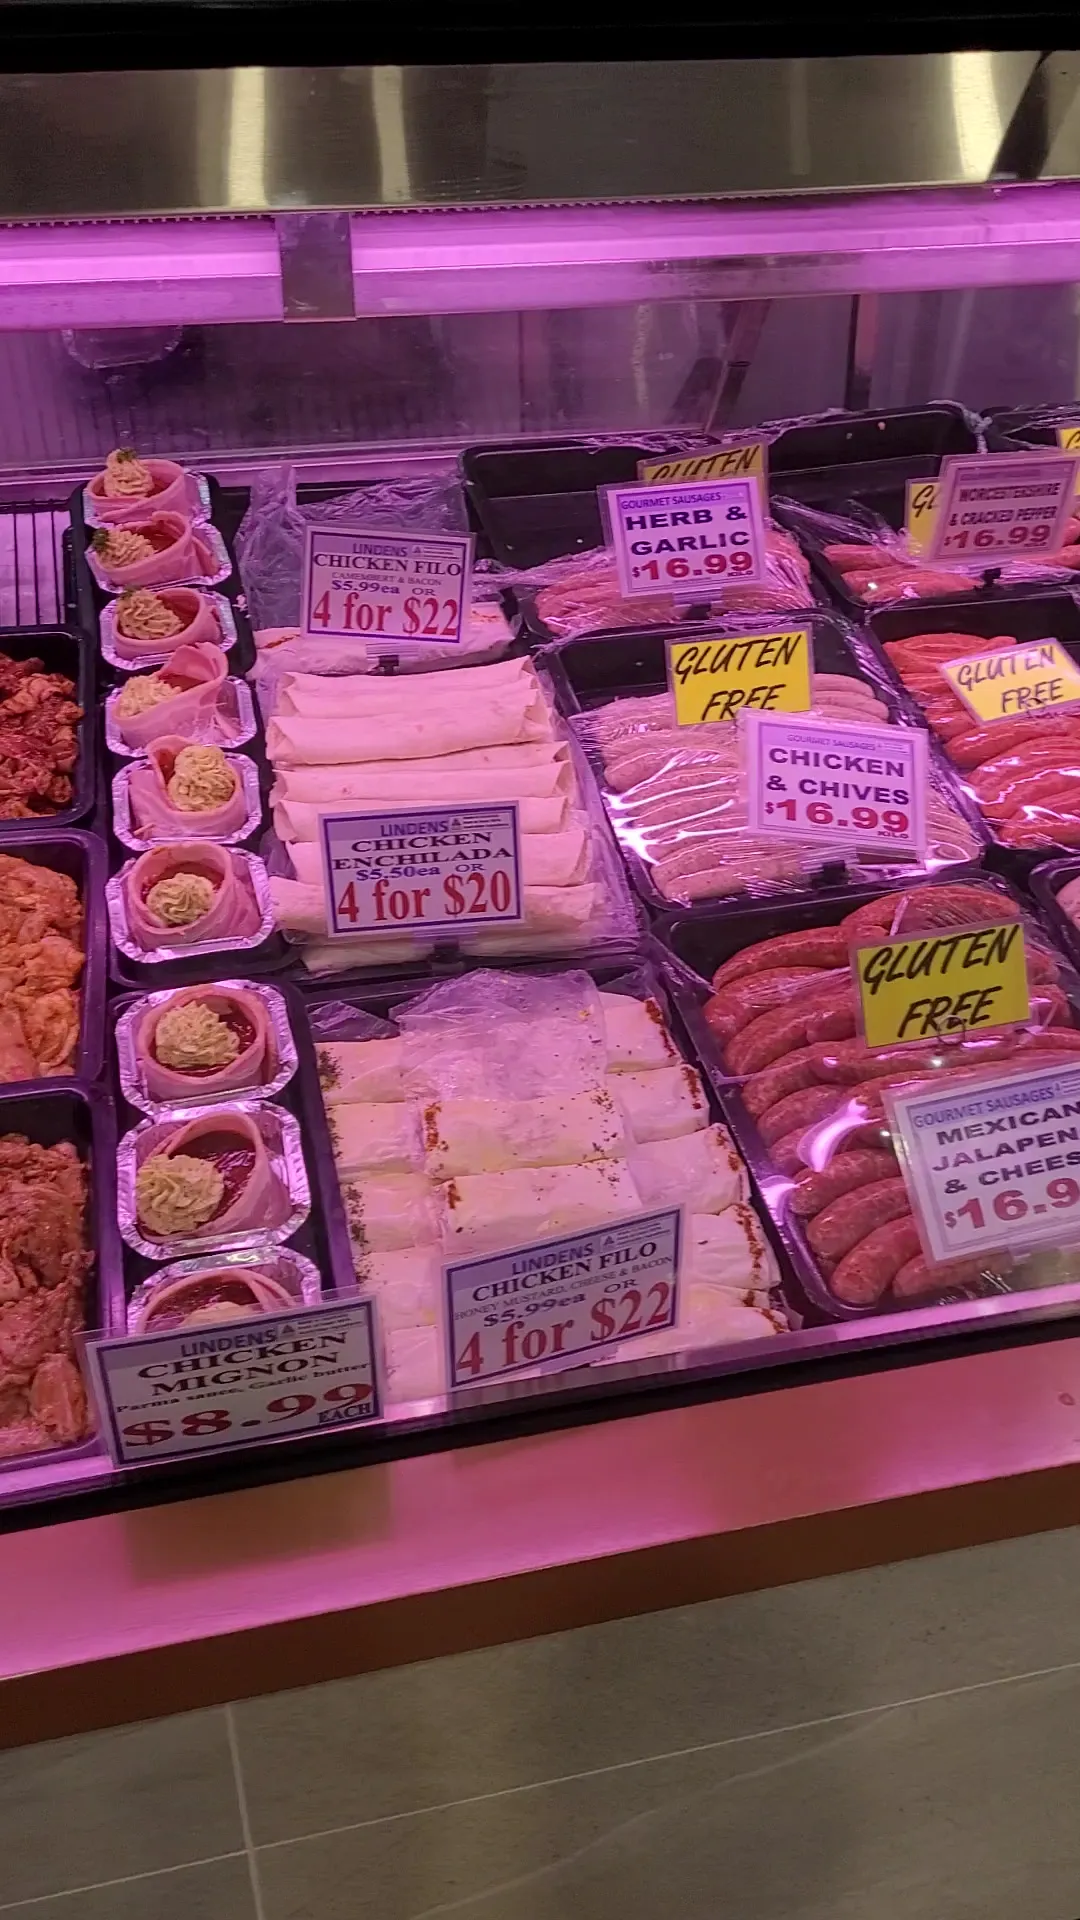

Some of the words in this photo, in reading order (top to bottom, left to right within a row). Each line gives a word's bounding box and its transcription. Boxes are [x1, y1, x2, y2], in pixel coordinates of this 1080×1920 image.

[621, 495, 670, 510] GOURMET
[672, 492, 721, 505] SAUSAGES
[1016, 506, 1058, 521] PEPPER
[625, 509, 713, 531] HERB
[725, 506, 747, 521] &
[352, 543, 408, 557] LINDENS
[631, 531, 750, 556] GARLIC
[944, 525, 1051, 548] $16.99
[314, 554, 408, 572] CHICKEN
[415, 561, 461, 576] FILO
[332, 572, 396, 583] CAMEMBERT
[398, 576, 405, 584] &
[407, 577, 442, 586] BACON
[632, 551, 753, 580] $16.99
[331, 580, 400, 594] $5.99ea
[412, 588, 436, 596] OR
[313, 590, 331, 628] 4
[343, 592, 392, 632] for
[402, 596, 458, 637] $22
[675, 634, 801, 685] GLUTEN
[957, 645, 1056, 691] GLUTEN
[1001, 678, 1064, 713] FREE
[787, 734, 830, 745] GOURMET
[832, 739, 876, 751] SAUSAGES
[769, 748, 905, 777] CHICKEN
[766, 775, 788, 791] &
[798, 778, 910, 805] CHIVES
[380, 820, 449, 837] LINDENS
[764, 799, 909, 833] $16.99
[351, 831, 493, 853] CHICKEN
[877, 830, 909, 839] KILO
[332, 847, 513, 870] ENCHILADA
[356, 866, 441, 882] $5.50ea
[455, 863, 486, 873] OR
[337, 881, 360, 923] 4
[372, 879, 431, 921] for
[443, 870, 511, 918] $20
[862, 924, 1020, 995] GLUTEN
[897, 985, 1003, 1038] FREE
[913, 1102, 984, 1128] GOURMET
[987, 1087, 1055, 1113] SAUSAGES
[936, 1101, 1080, 1145] MEXICAN
[944, 1178, 968, 1194] &
[472, 1259, 592, 1302] CHICKEN
[599, 1241, 657, 1270] FILO
[511, 1242, 594, 1276] LINDENS
[454, 1301, 499, 1321] HONEY
[569, 1271, 617, 1290] CHEESE
[619, 1267, 628, 1277] &
[631, 1256, 673, 1274] BACON
[484, 1293, 586, 1328] $5.99ea
[604, 1278, 639, 1294] OR
[180, 1327, 278, 1358] LINDENS
[456, 1331, 484, 1375] 4
[502, 1319, 575, 1367] for
[590, 1281, 671, 1345] $22
[138, 1331, 349, 1379] CHICKEN
[116, 1396, 180, 1414] Parma
[248, 1373, 308, 1391] Garlic
[313, 1362, 368, 1379] butter
[151, 1351, 341, 1397] MIGNON
[121, 1383, 374, 1448] $8.99
[318, 1401, 372, 1425] EACH
